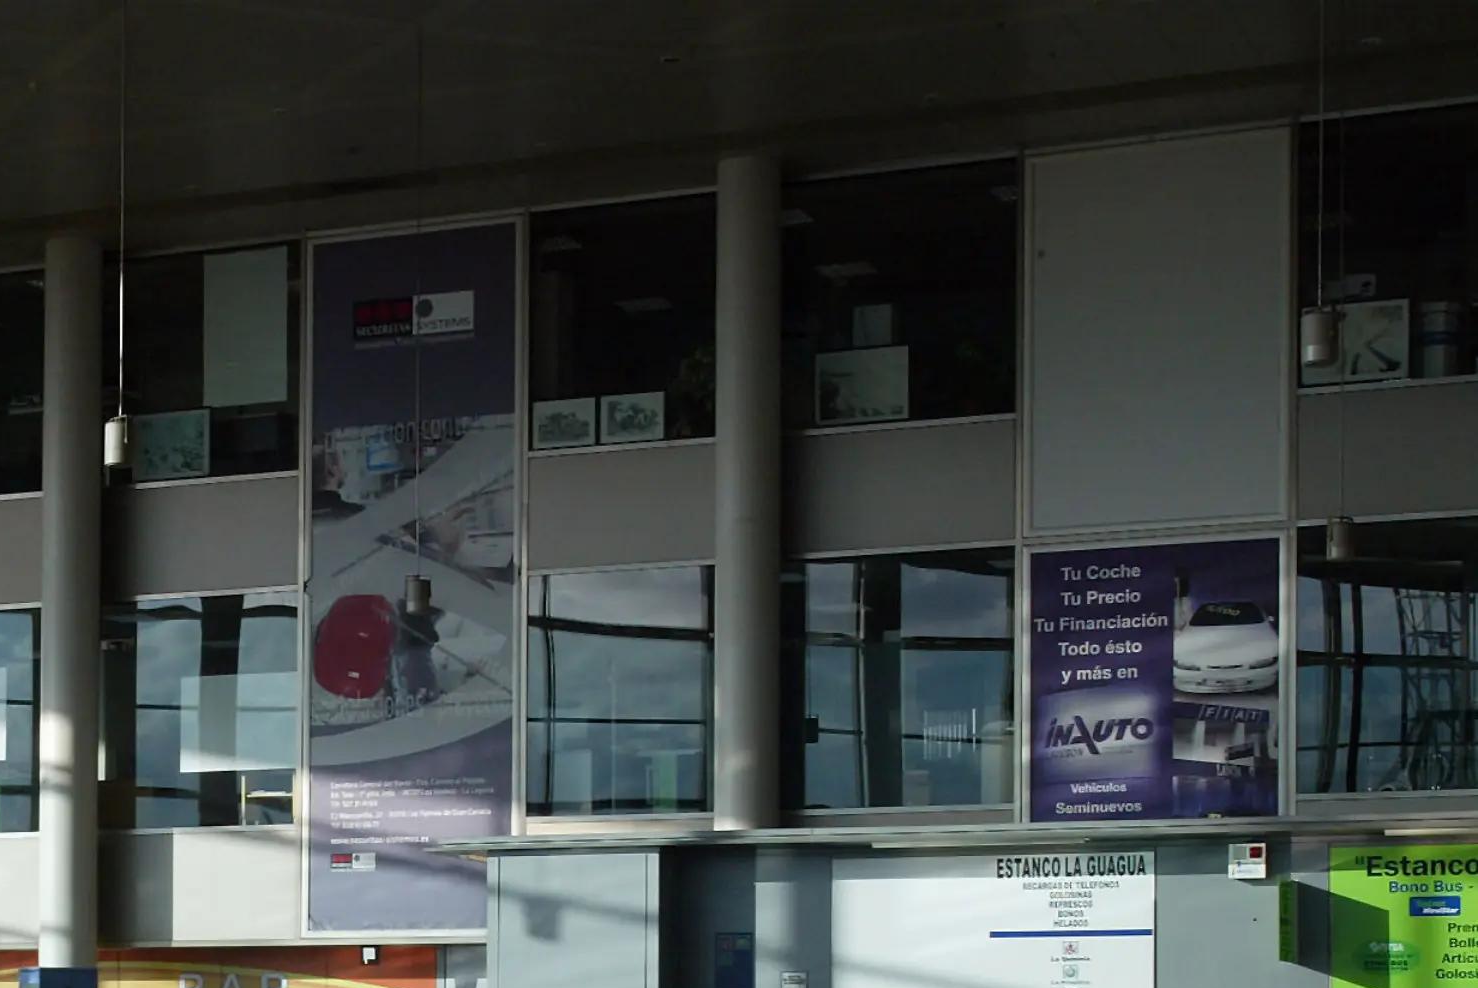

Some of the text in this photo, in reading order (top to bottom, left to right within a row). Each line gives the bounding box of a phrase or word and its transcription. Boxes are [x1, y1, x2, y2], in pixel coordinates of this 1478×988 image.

[1060, 564, 1142, 582] Tu Coche
[1060, 589, 1142, 606] Tu Precio
[1034, 613, 1169, 632] Tu Financiación
[1057, 640, 1143, 657] Todo ésto
[1061, 665, 1139, 685] y más en
[1055, 800, 1143, 815] Seminuevos
[996, 854, 1147, 878] ESTANCO LA GUAGUA
[1388, 880, 1428, 893] Bono
[1434, 880, 1463, 893] Bus
